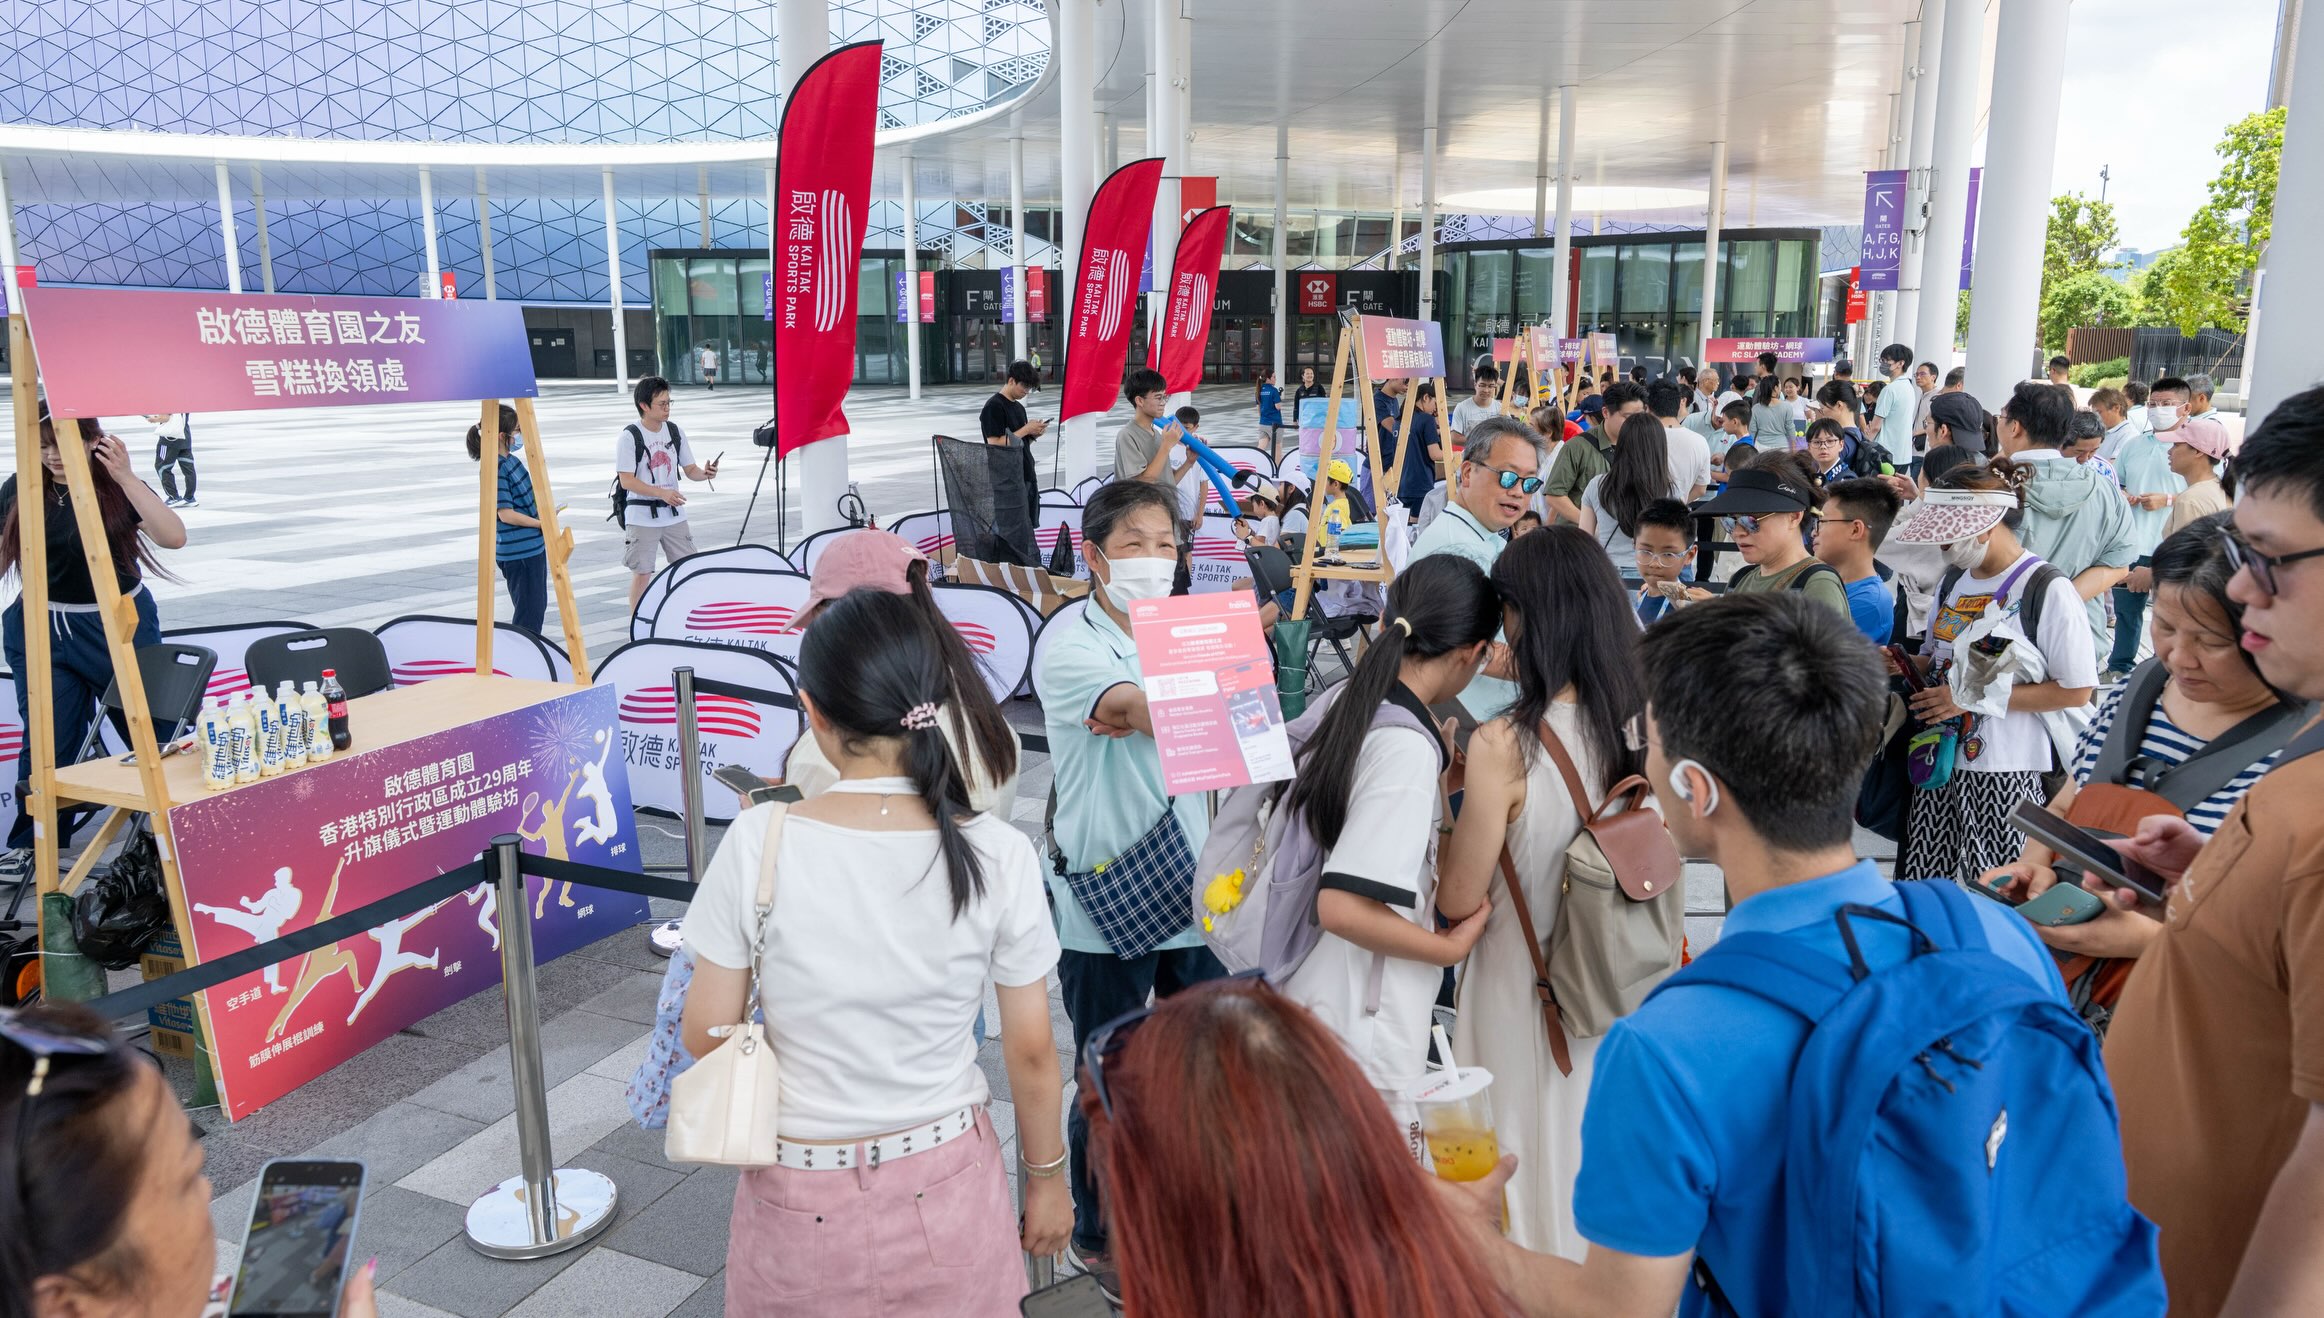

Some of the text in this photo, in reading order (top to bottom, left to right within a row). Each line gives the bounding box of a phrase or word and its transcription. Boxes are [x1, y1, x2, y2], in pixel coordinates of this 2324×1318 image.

[789, 190, 816, 241] 啟德
[1862, 248, 1898, 261] H, J, K
[1864, 233, 1900, 246] A, F, G,
[799, 245, 813, 294] KAI TAK
[1088, 248, 1109, 281] 啟德
[785, 245, 799, 329] SPORTS PARK
[966, 290, 980, 310] F
[1090, 284, 1103, 315] KAI TAK
[1079, 283, 1094, 337] SPORTS PARK
[1173, 298, 1182, 320] SPORTS
[196, 307, 426, 345] 啟德體育園之友
[1474, 338, 1489, 348] KAI
[245, 358, 409, 396] 雪糕換領處
[1197, 574, 1230, 582] SPORTS
[1199, 564, 1213, 572] KAI
[1216, 564, 1232, 574] TAK
[384, 752, 474, 798] 啟德體育園
[665, 756, 714, 776] SPTS
[319, 758, 534, 848] 香港特別行政區成立29周年
[344, 788, 519, 866] 升旗儀式暨運動體驗坊
[610, 842, 626, 856] 排球
[226, 986, 262, 1012] 空手道
[248, 1021, 324, 1068] 筋膜伸展棍訓練
